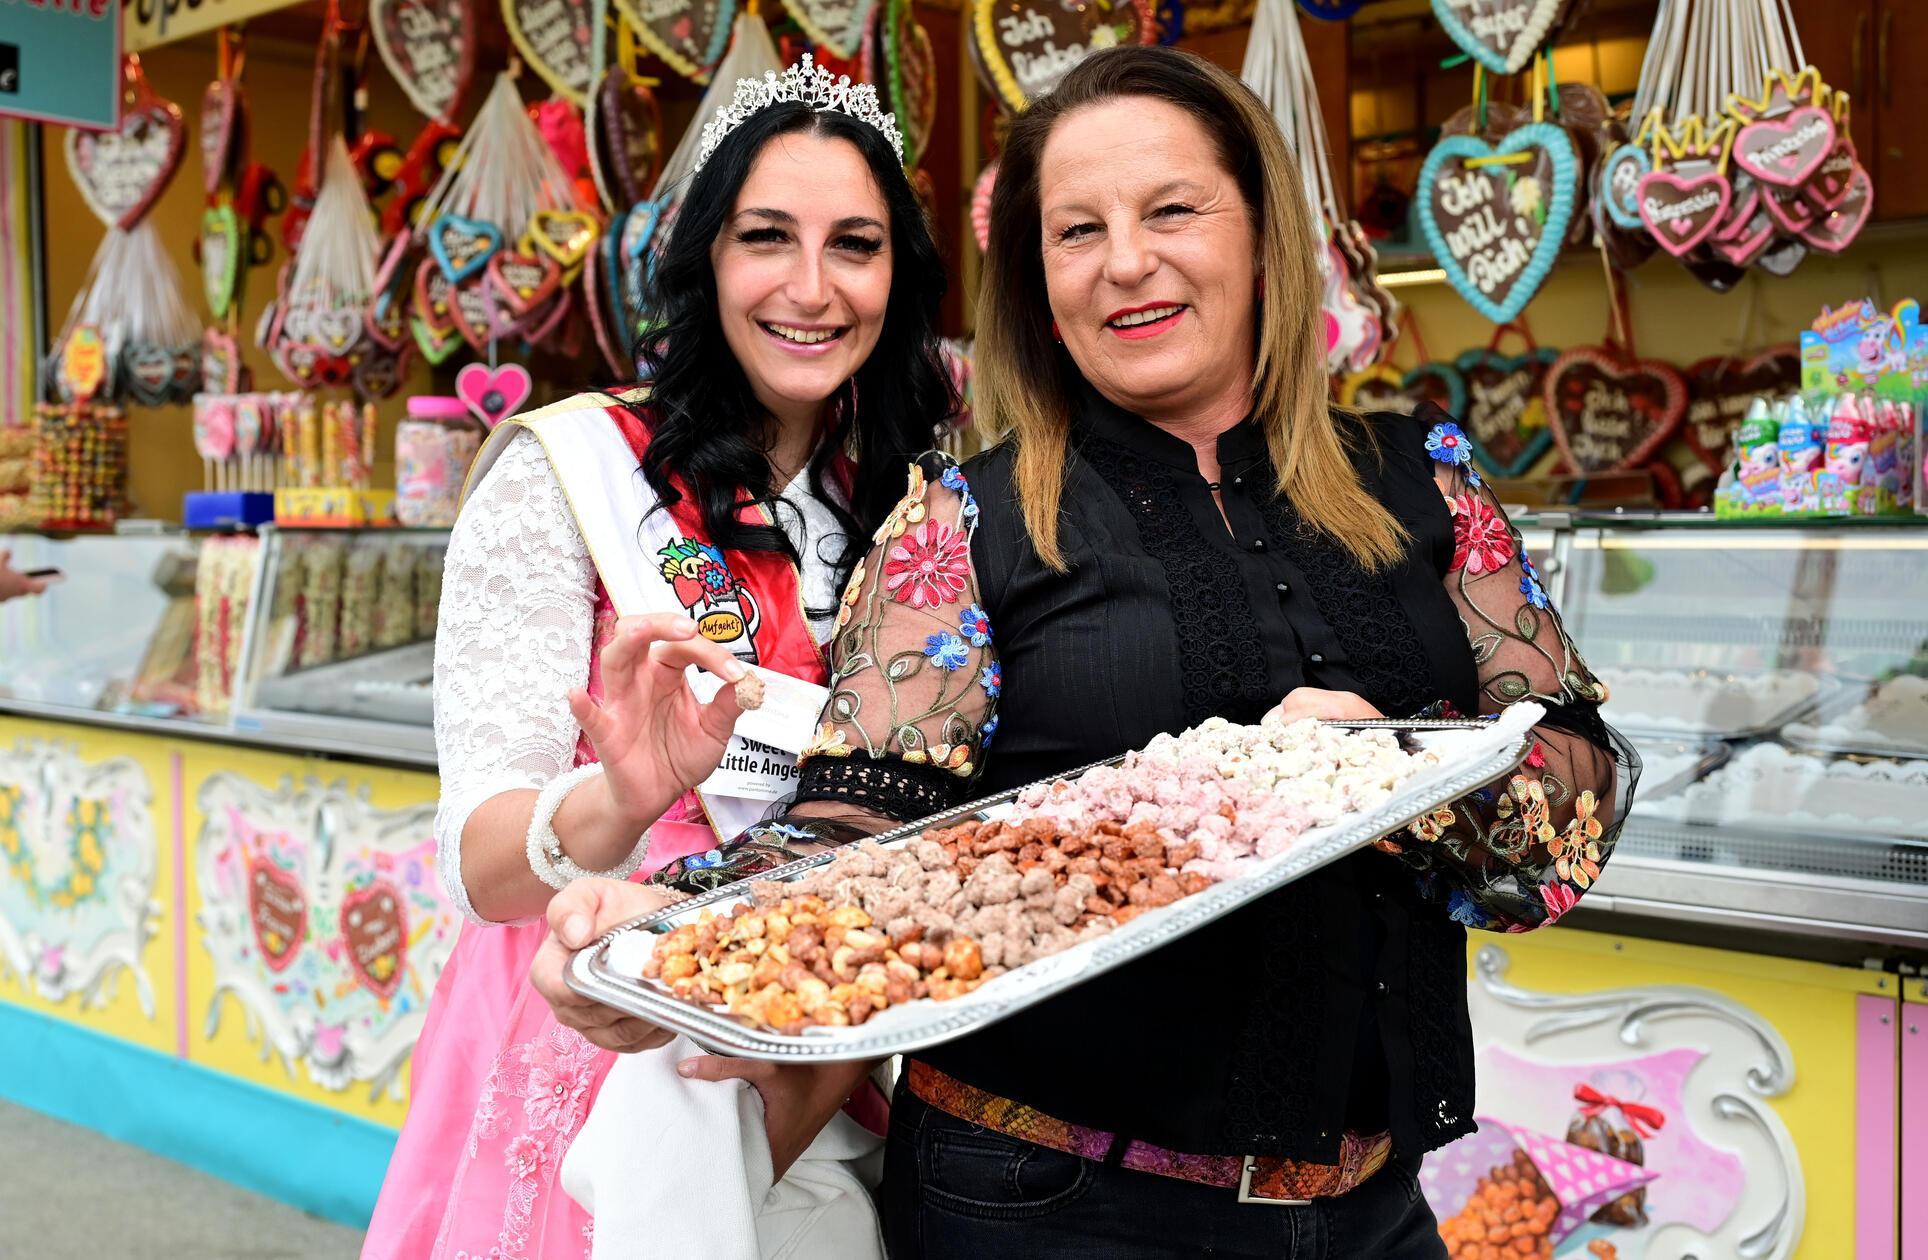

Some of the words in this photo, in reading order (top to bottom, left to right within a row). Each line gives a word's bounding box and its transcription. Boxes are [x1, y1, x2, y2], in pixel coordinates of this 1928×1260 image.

[999, 9, 1055, 47] Ich
[1439, 172, 1494, 216] Ich
[1446, 205, 1507, 259] will
[760, 757, 801, 781] Ange
